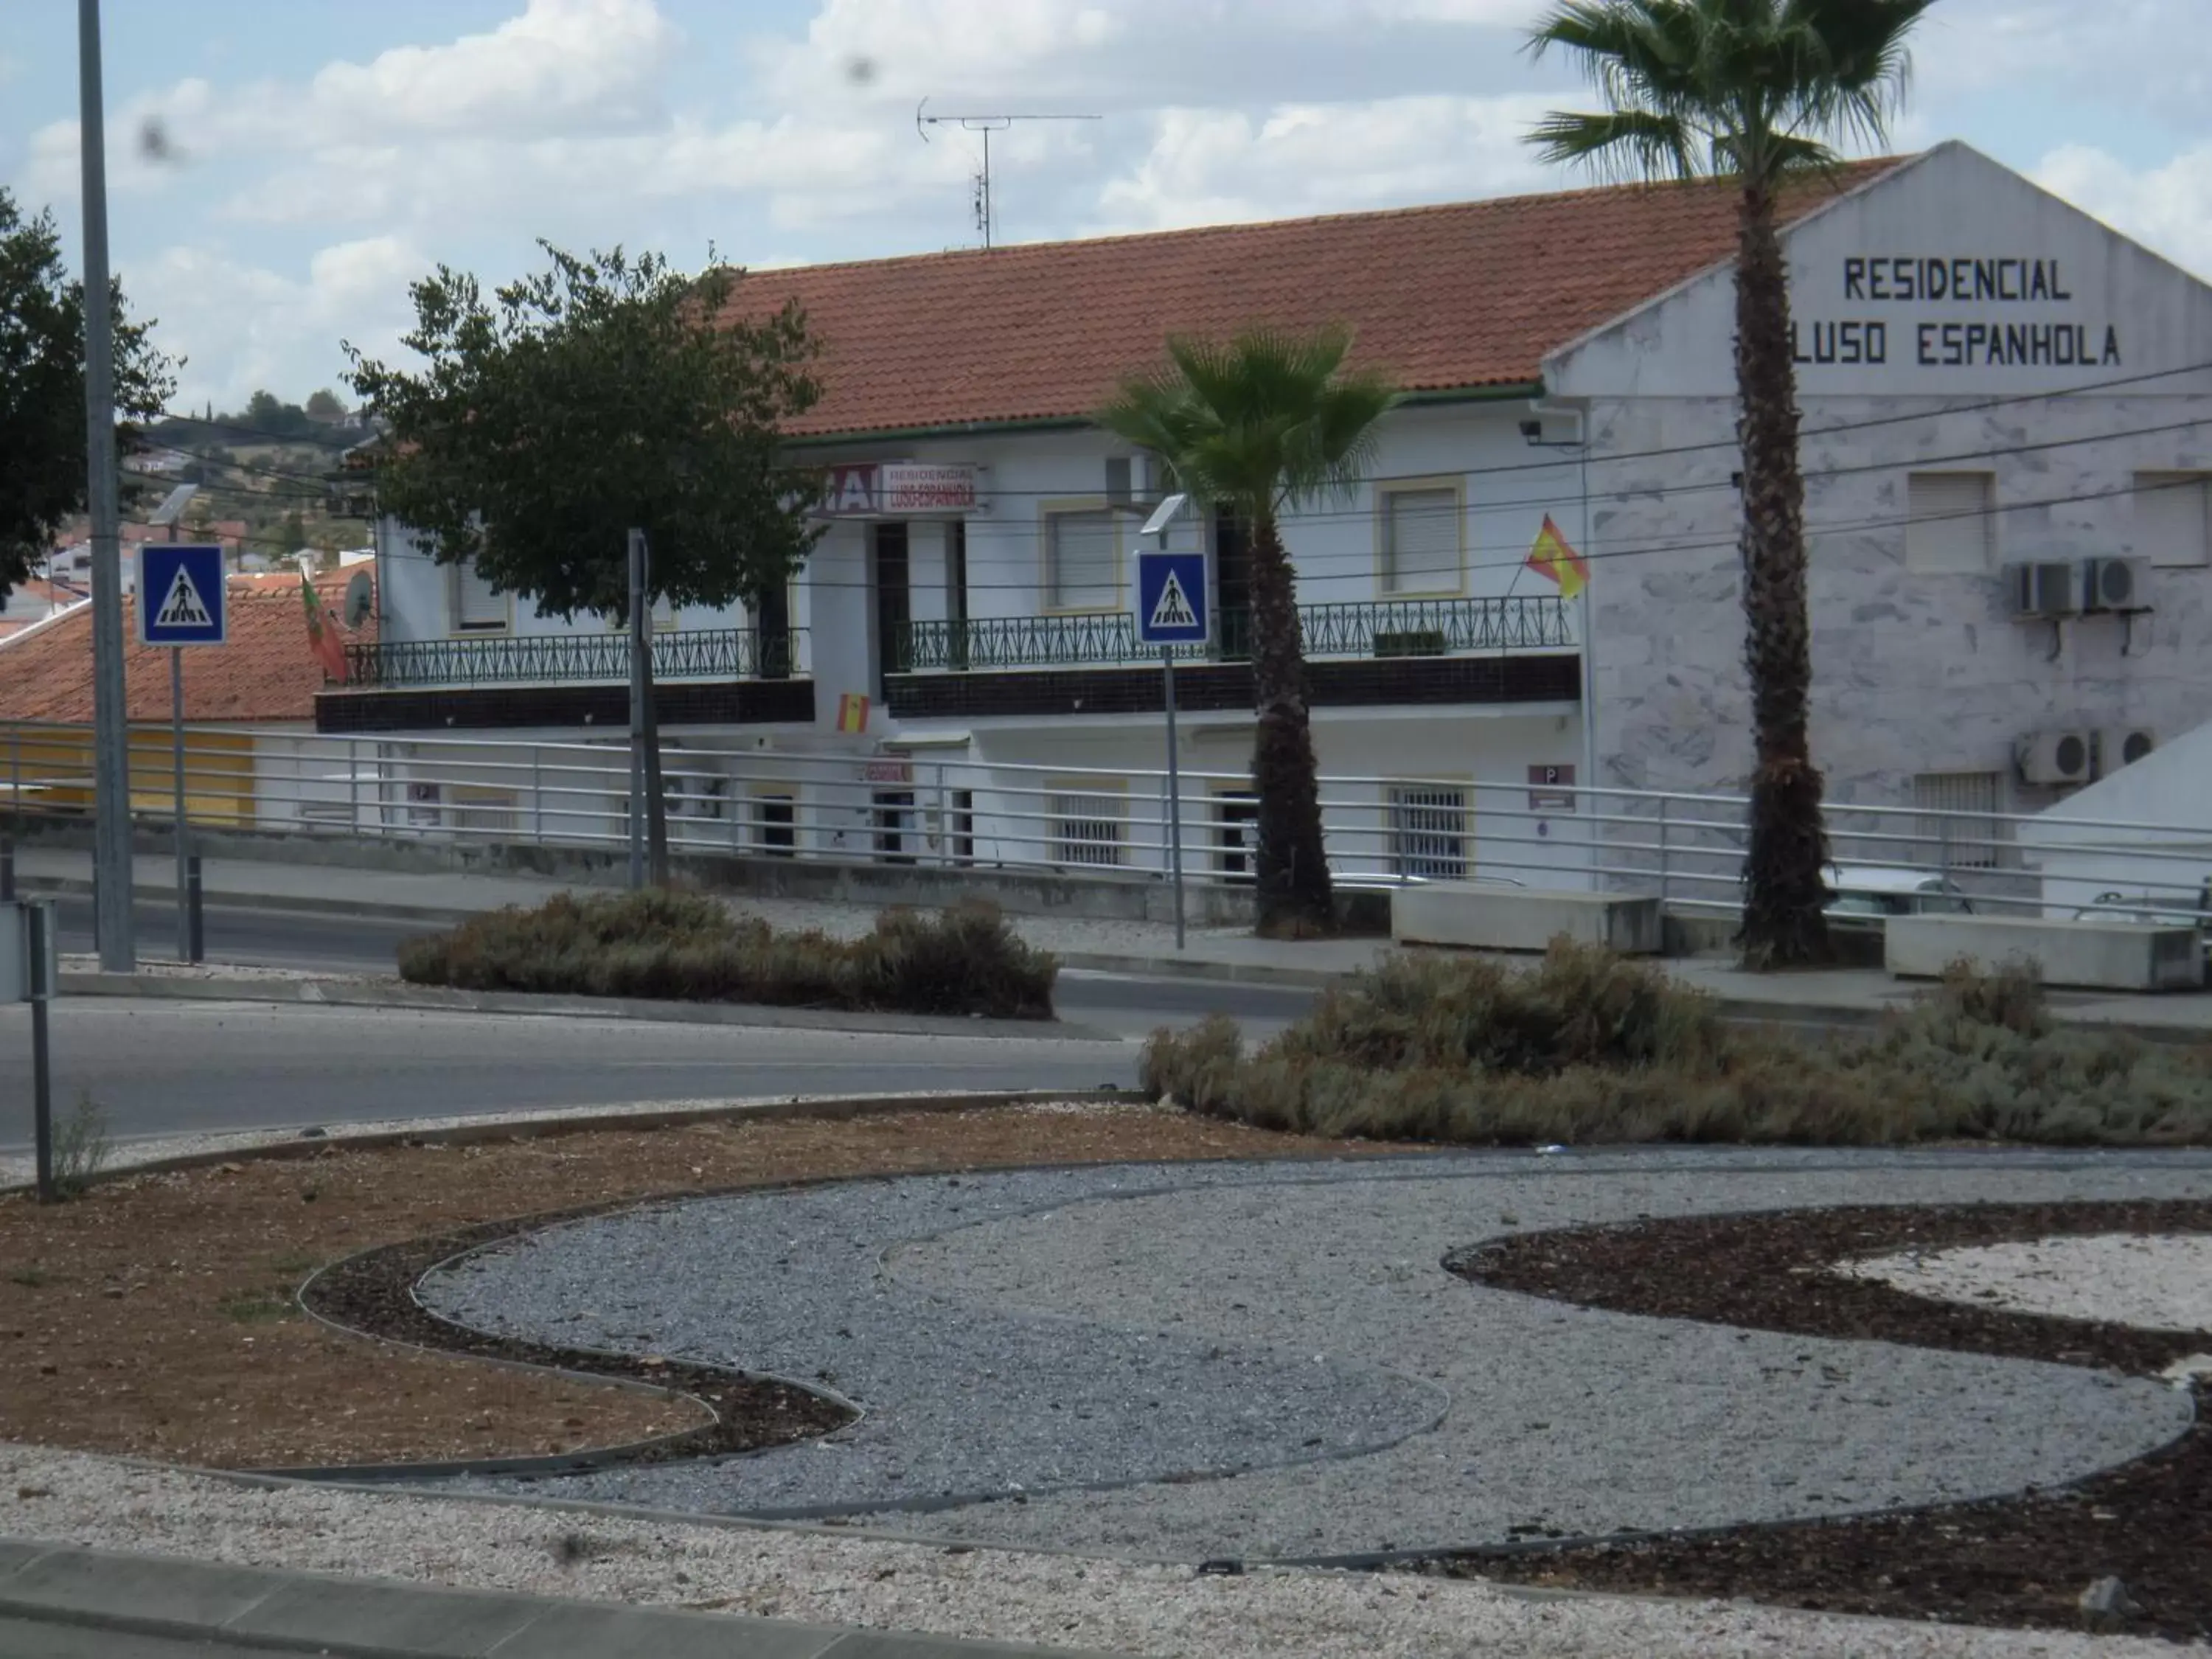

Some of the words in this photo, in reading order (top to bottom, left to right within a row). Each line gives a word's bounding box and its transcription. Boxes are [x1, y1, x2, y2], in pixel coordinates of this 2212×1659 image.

[1845, 257, 2072, 301] RESIDENCIAL
[1790, 320, 1886, 364] LUSO
[1917, 323, 2121, 366] ESPANHOLA
[890, 469, 973, 481] RESIDENCIAL
